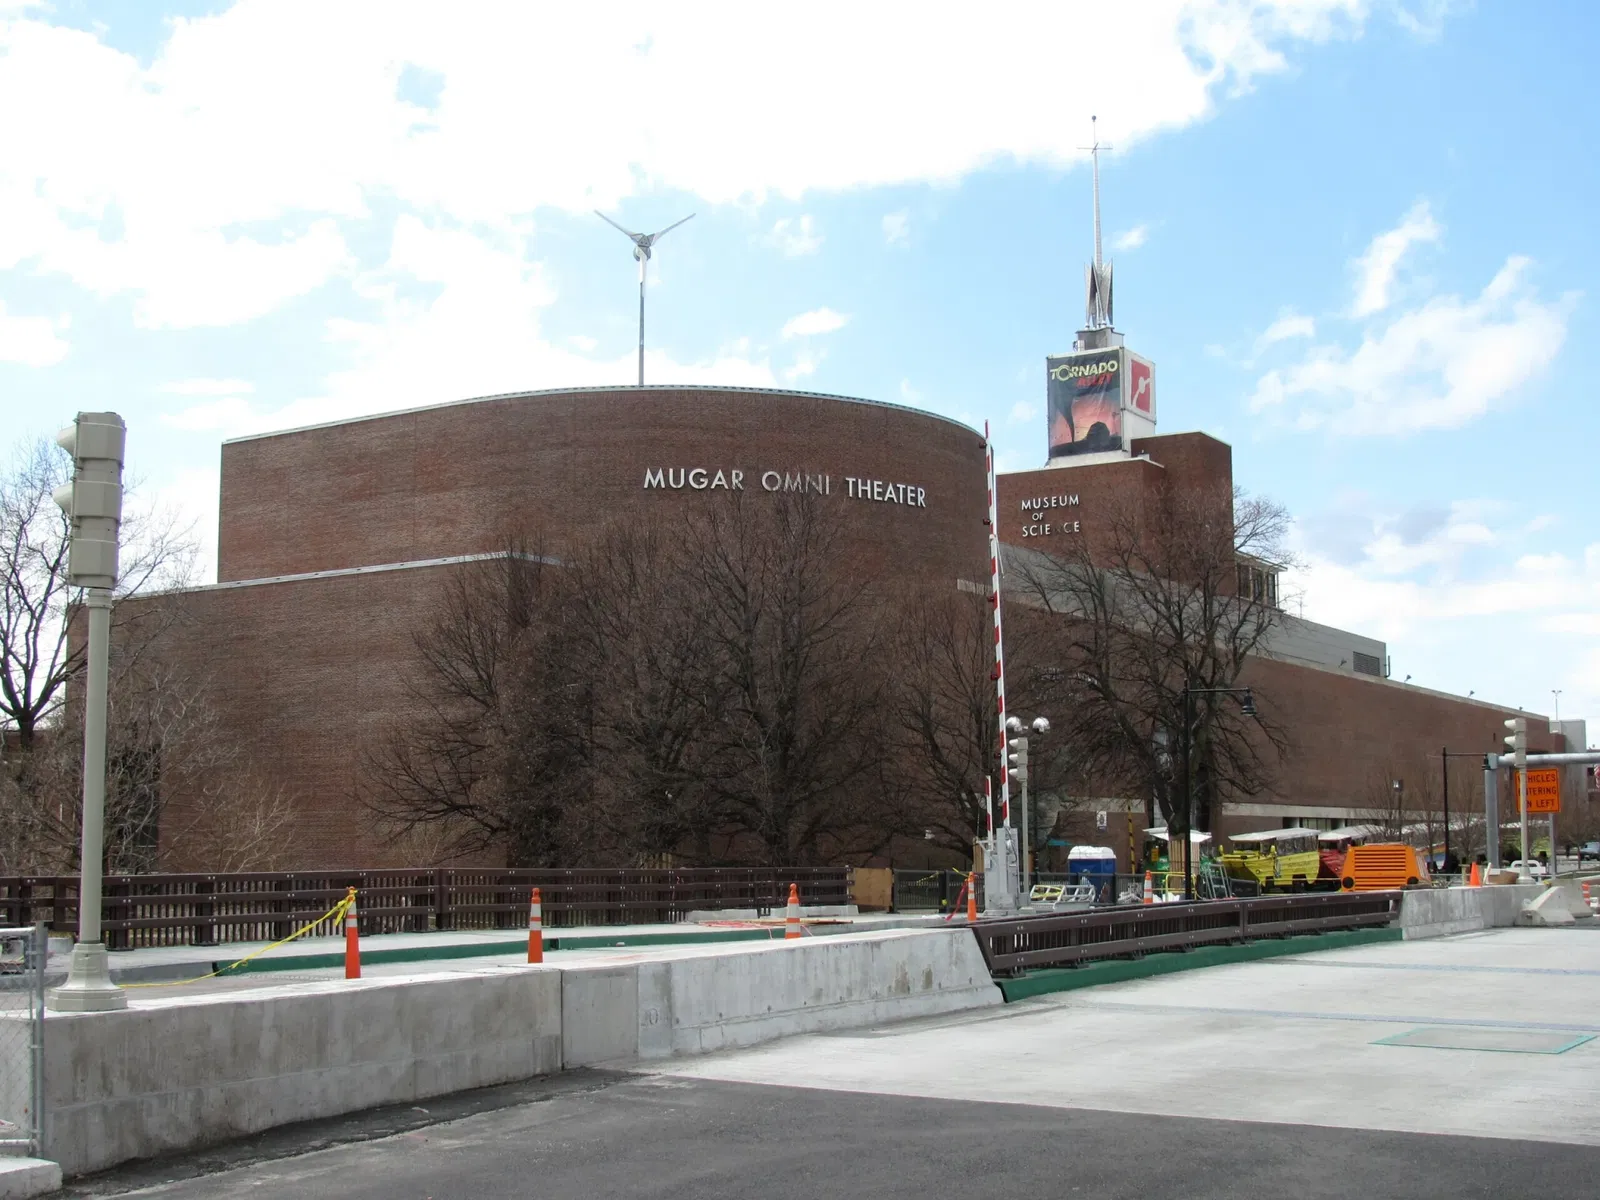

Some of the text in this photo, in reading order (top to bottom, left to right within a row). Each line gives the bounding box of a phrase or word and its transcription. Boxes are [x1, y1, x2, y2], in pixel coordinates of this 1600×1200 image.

[1049, 360, 1118, 381] TORNADO
[643, 467, 926, 508] MUGAR OMNI THEATER
[1021, 494, 1079, 510] MUSEUM
[1031, 512, 1044, 521] OF
[1022, 521, 1080, 537] SCIECE
[1517, 773, 1556, 783] HICLES
[1518, 786, 1557, 796] TERING
[1536, 799, 1555, 808] LEFT
